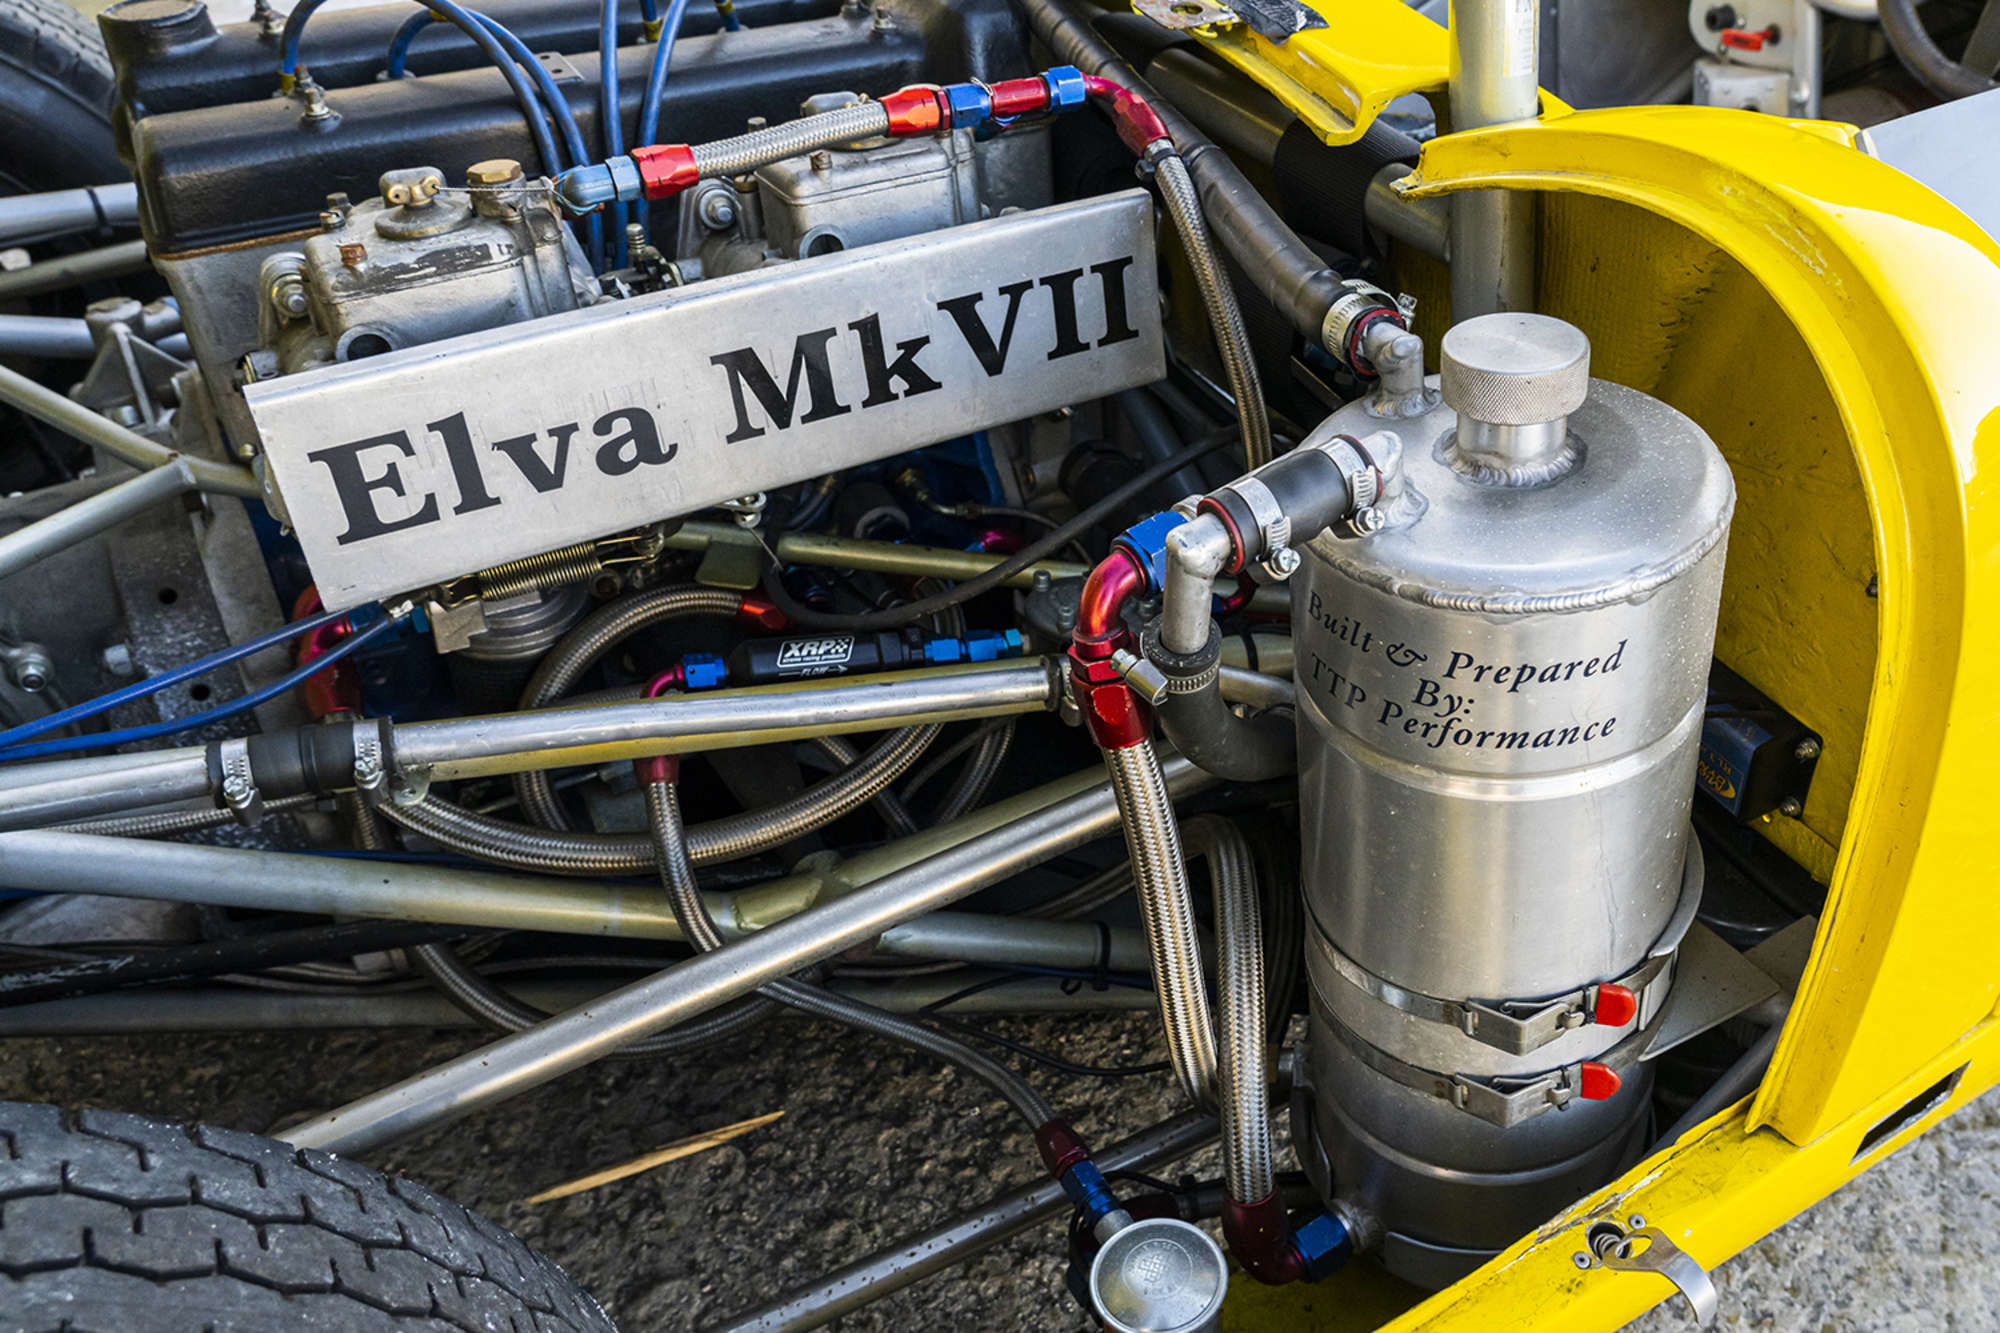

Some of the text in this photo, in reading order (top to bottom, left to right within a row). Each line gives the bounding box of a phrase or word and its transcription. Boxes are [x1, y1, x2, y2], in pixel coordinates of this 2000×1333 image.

[308, 408, 678, 546] Elva
[783, 639, 836, 658] XRP
[1307, 590, 1628, 693] Built & Prepared
[1311, 653, 1617, 749] TTP Performance
[1411, 677, 1475, 718] By:
